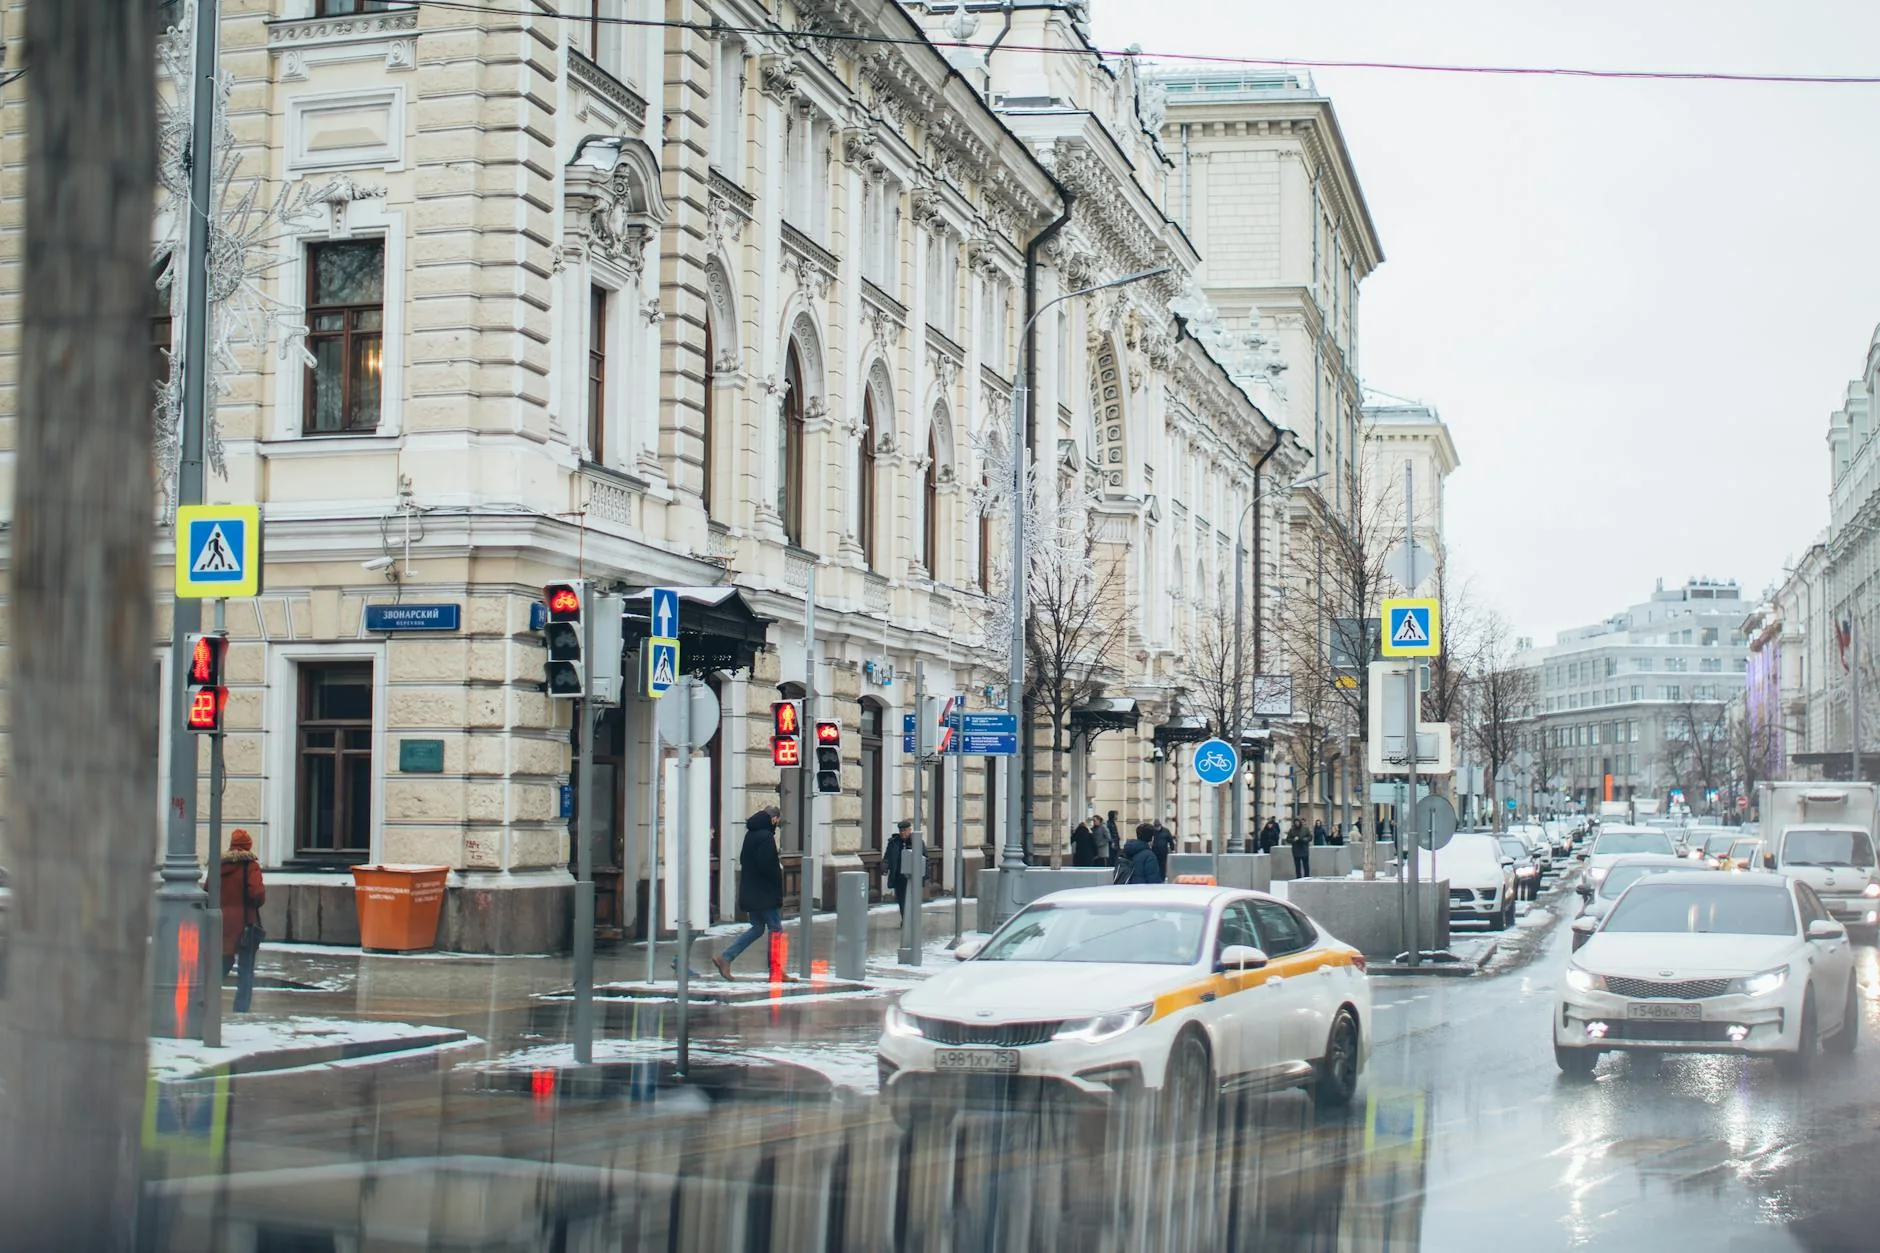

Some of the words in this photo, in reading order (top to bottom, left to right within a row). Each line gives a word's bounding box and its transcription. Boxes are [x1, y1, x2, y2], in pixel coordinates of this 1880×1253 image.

[383, 608, 439, 619] ЗВОНАРСКИЙ
[191, 695, 212, 722] 22
[779, 741, 797, 761] 22
